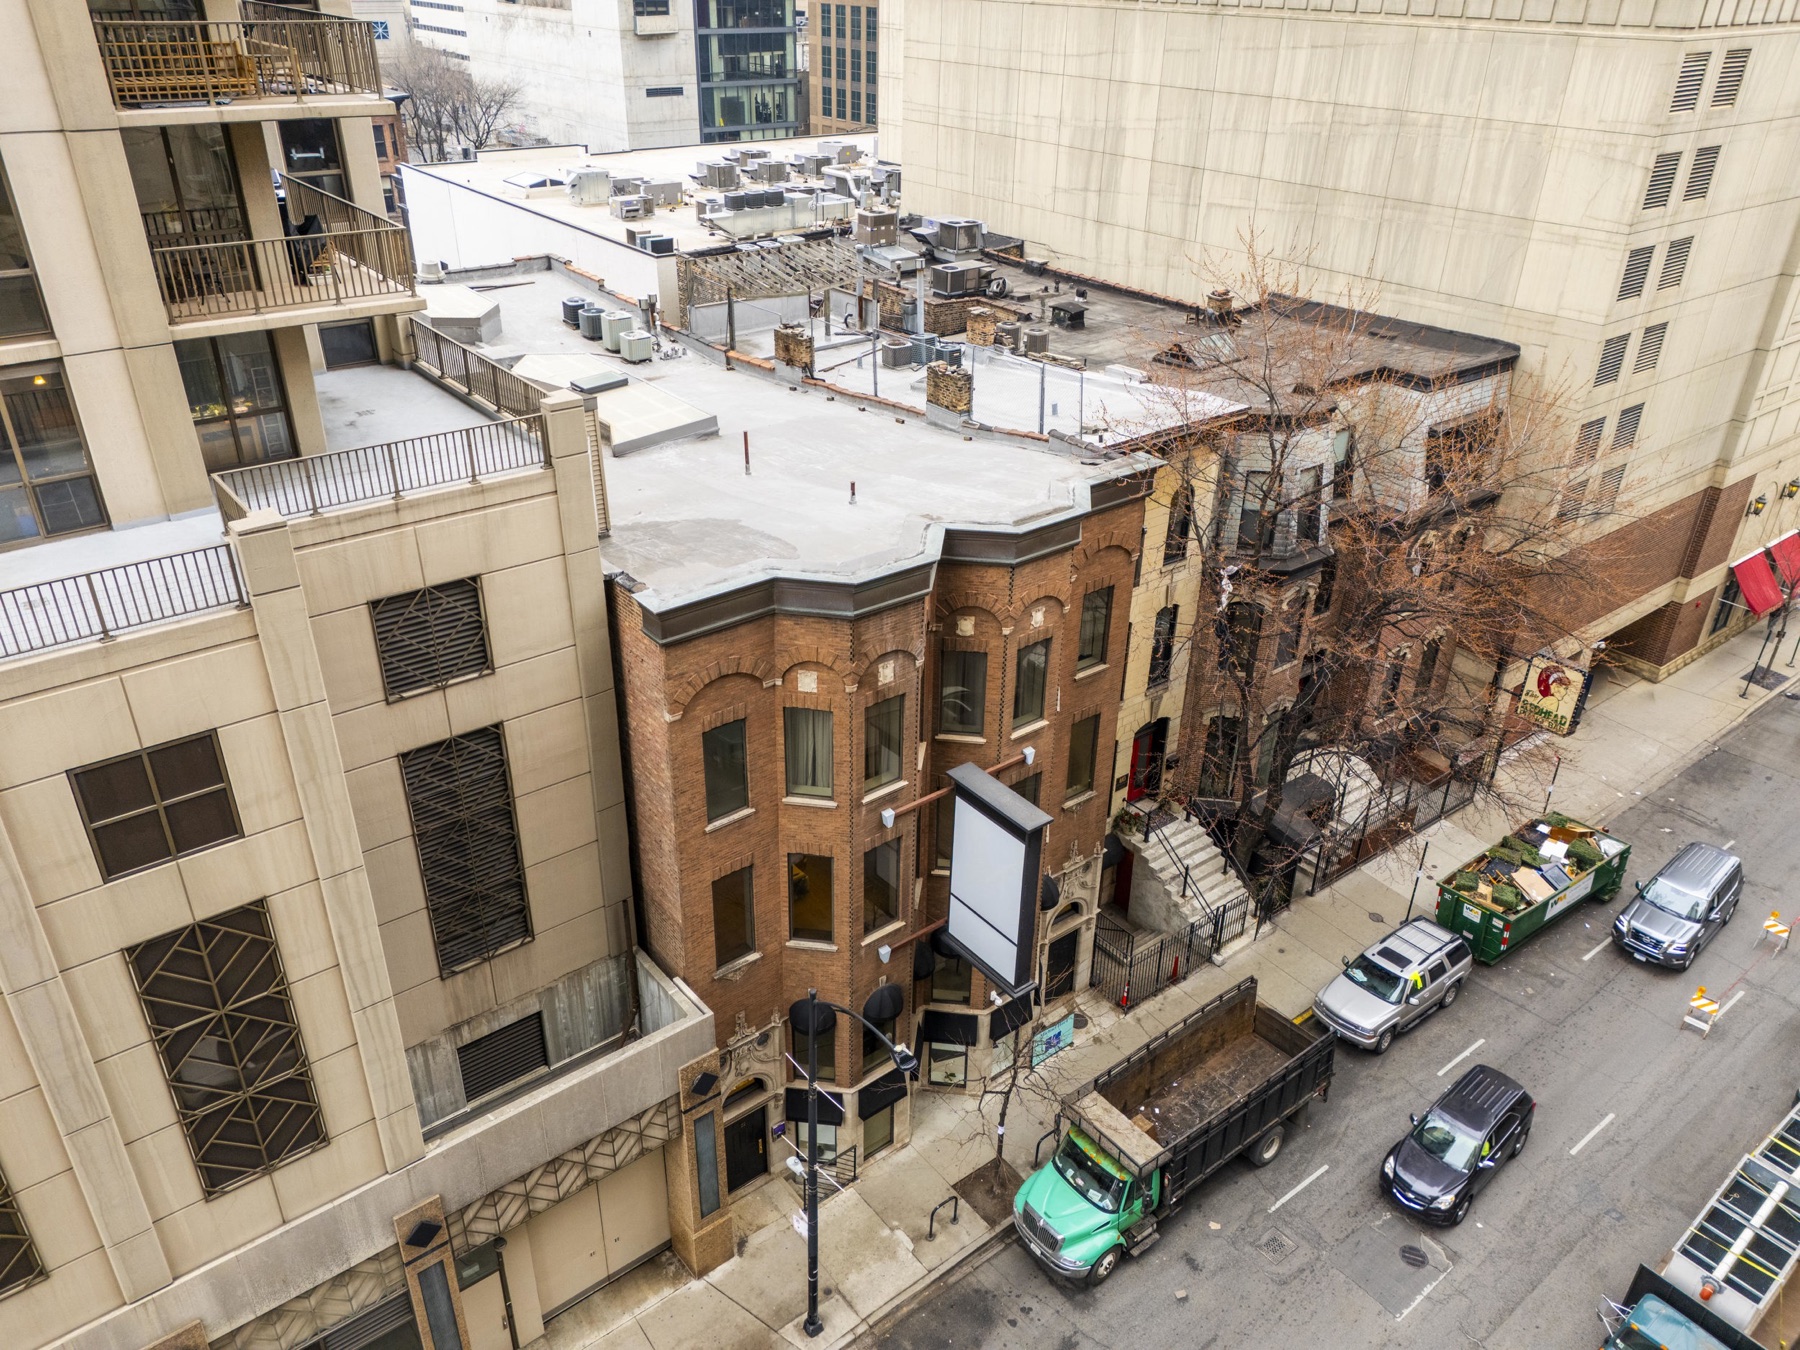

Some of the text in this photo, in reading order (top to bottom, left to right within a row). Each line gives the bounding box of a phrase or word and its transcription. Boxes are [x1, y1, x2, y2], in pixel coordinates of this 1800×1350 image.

[1524, 690, 1539, 698] The
[1521, 699, 1567, 726] REDHEAD
[1548, 721, 1564, 733] BAR
